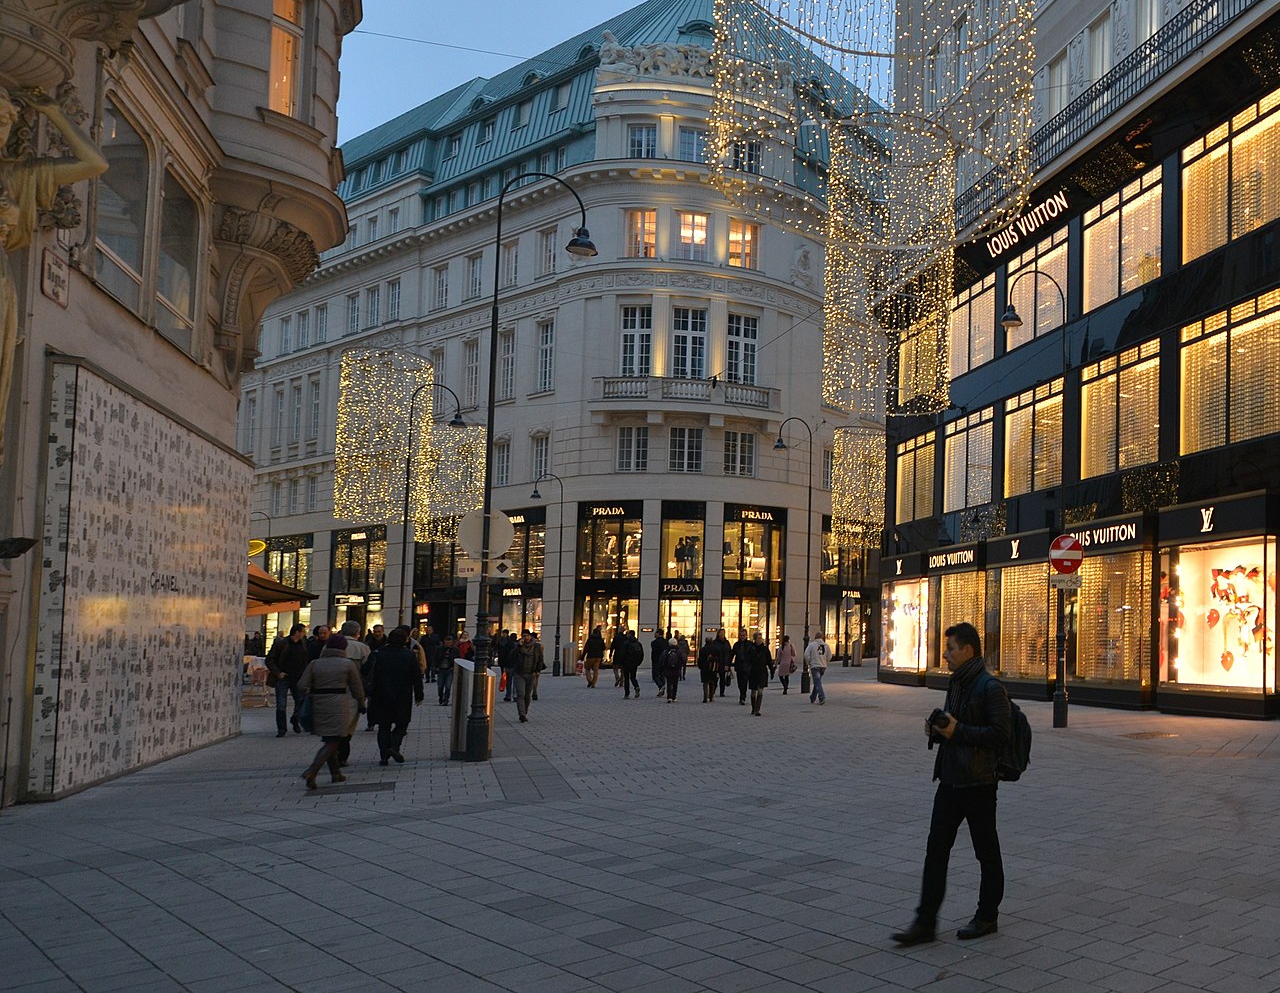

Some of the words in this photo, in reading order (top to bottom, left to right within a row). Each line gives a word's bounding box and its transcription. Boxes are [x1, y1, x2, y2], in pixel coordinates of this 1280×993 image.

[986, 223, 1019, 258] LOUIS
[1015, 190, 1069, 237] VUITTON
[592, 507, 625, 516] PRADA
[741, 510, 773, 521] PRADA
[1200, 507, 1214, 533] LV
[1092, 523, 1137, 545] VUITTON
[1010, 539, 1020, 559] LV
[895, 559, 903, 575] LV
[929, 553, 946, 569] LOUIS
[947, 550, 974, 566] VUITTON
[150, 571, 179, 592] CHANEL
[664, 584, 700, 592] PRADA
[503, 588, 522, 596] PRADA
